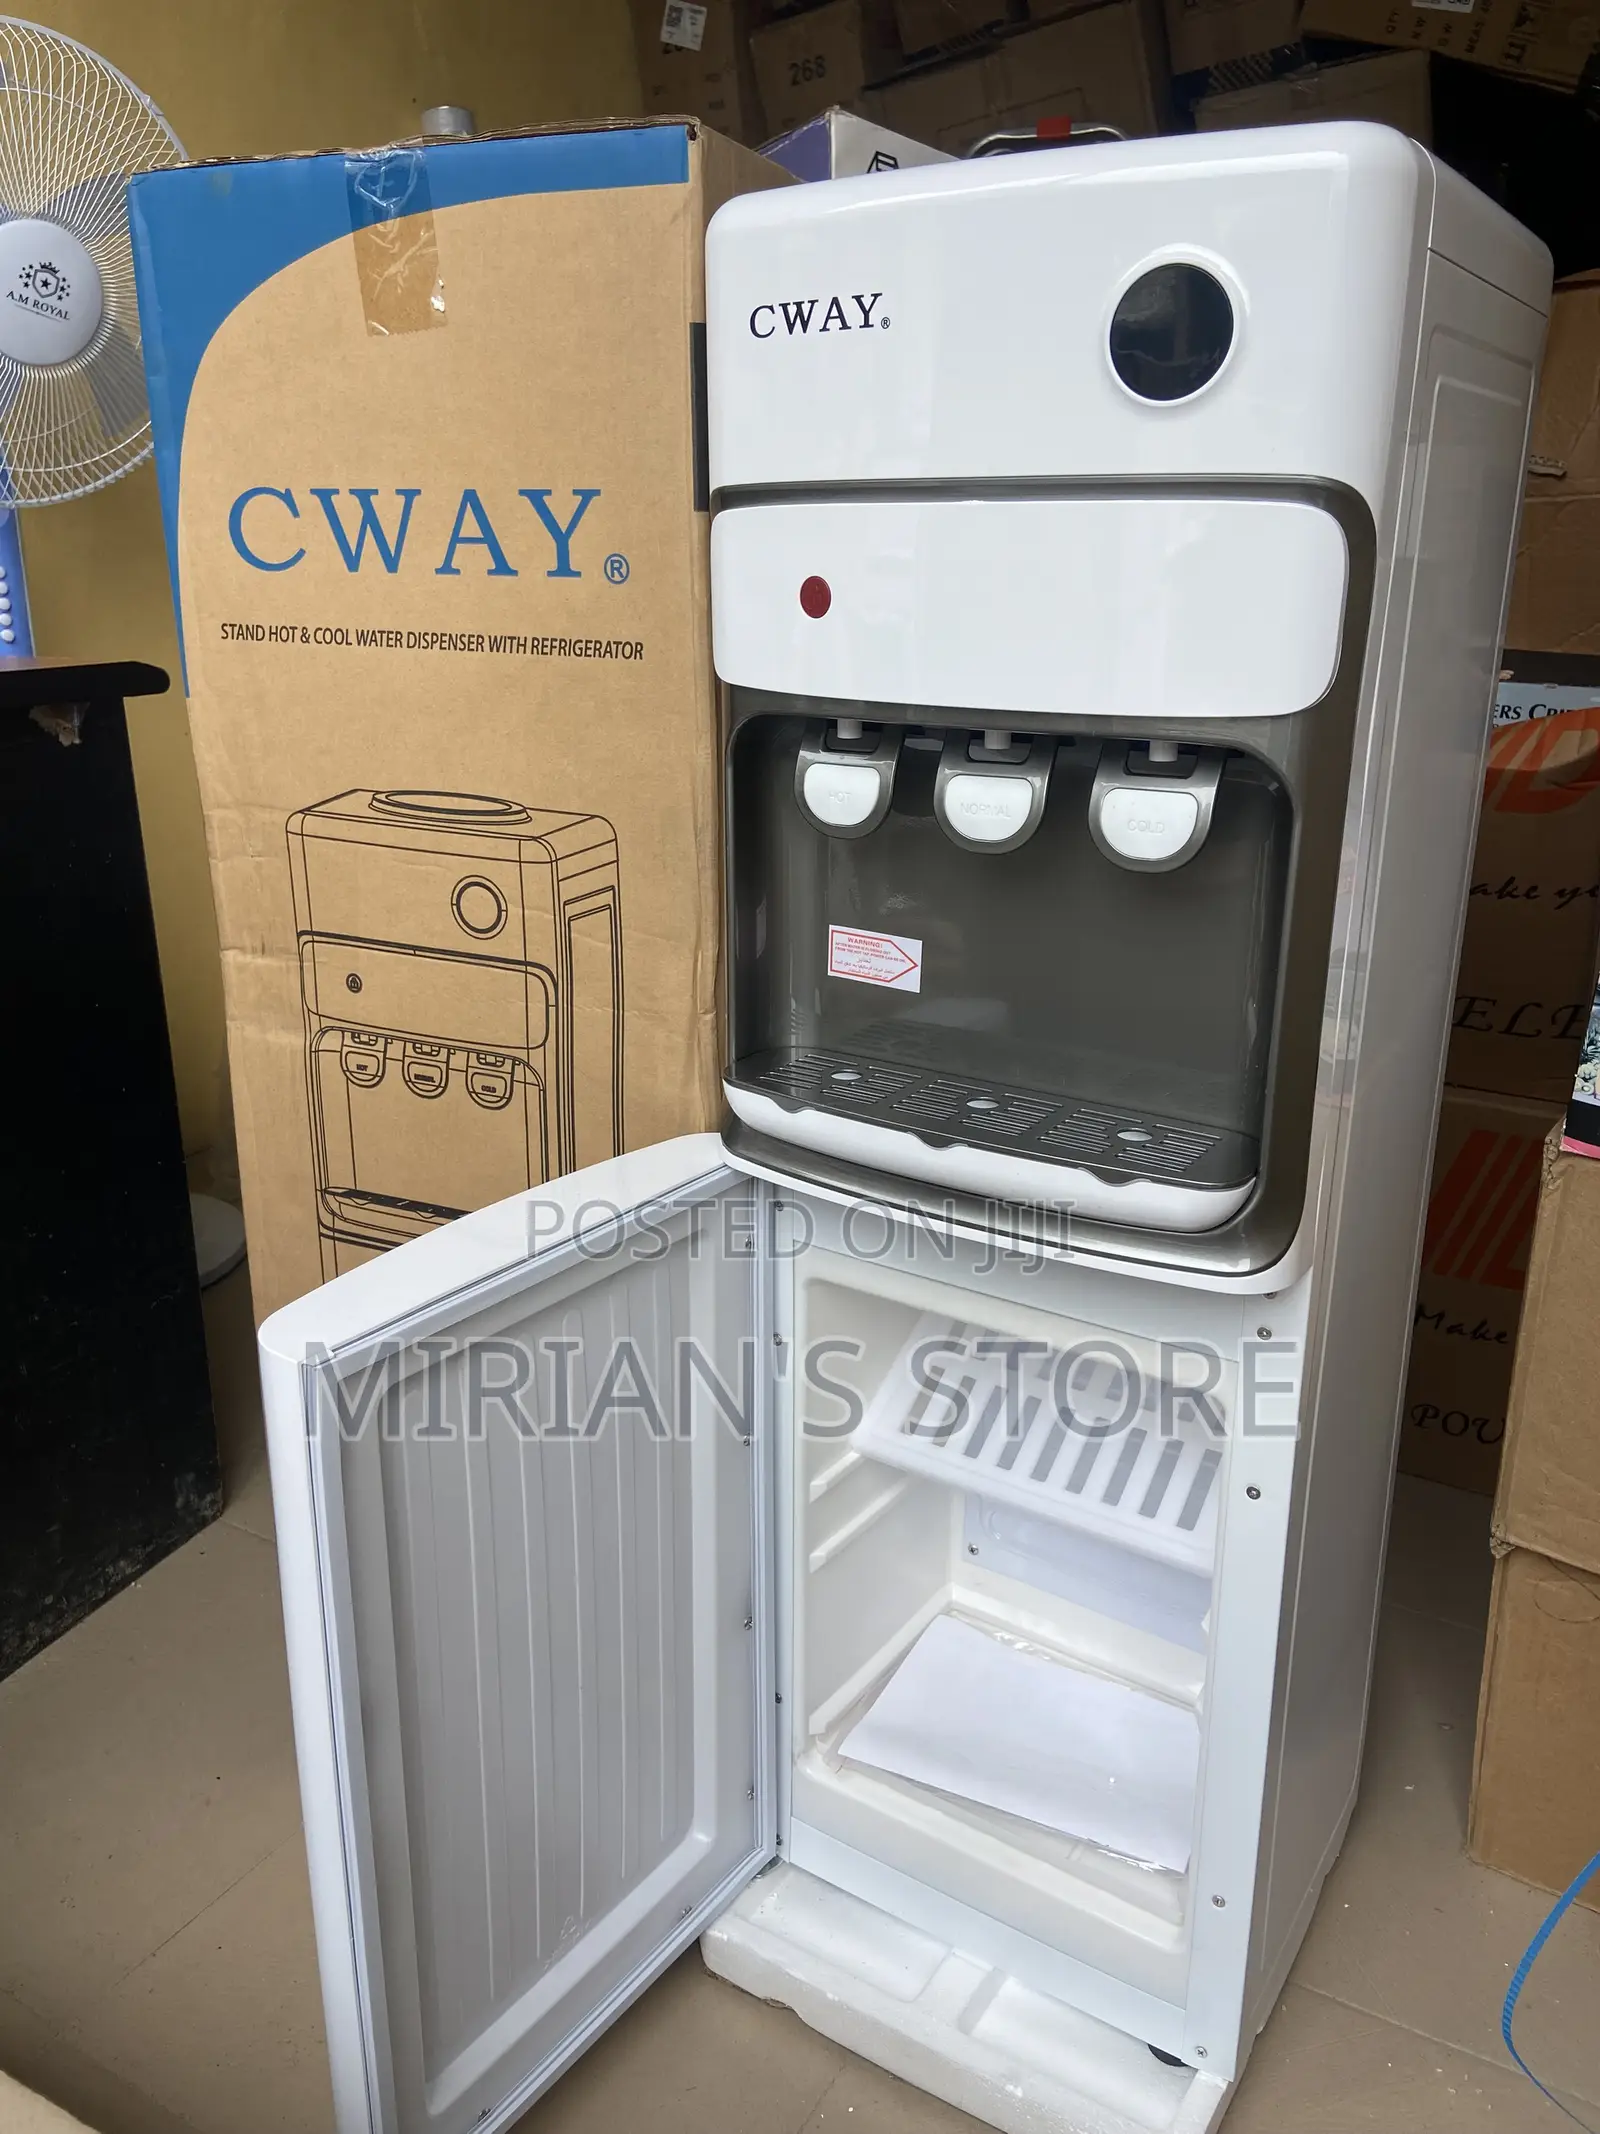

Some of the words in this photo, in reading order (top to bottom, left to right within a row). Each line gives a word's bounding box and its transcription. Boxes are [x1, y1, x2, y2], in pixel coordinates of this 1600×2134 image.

[789, 56, 826, 86] 268
[6, 290, 29, 306] A.M
[32, 299, 71, 320] ROYAL
[220, 623, 266, 642] STAND
[268, 625, 298, 643] HOT
[300, 626, 311, 644] &
[313, 627, 353, 646] COOL
[355, 629, 404, 649] WATER
[406, 631, 485, 653] DISPENSER
[488, 635, 528, 656] WITH
[530, 637, 645, 661] REFRIGERATOR
[828, 791, 852, 803] HOT
[960, 802, 1012, 820] NORMAL
[1126, 817, 1165, 835] COLD
